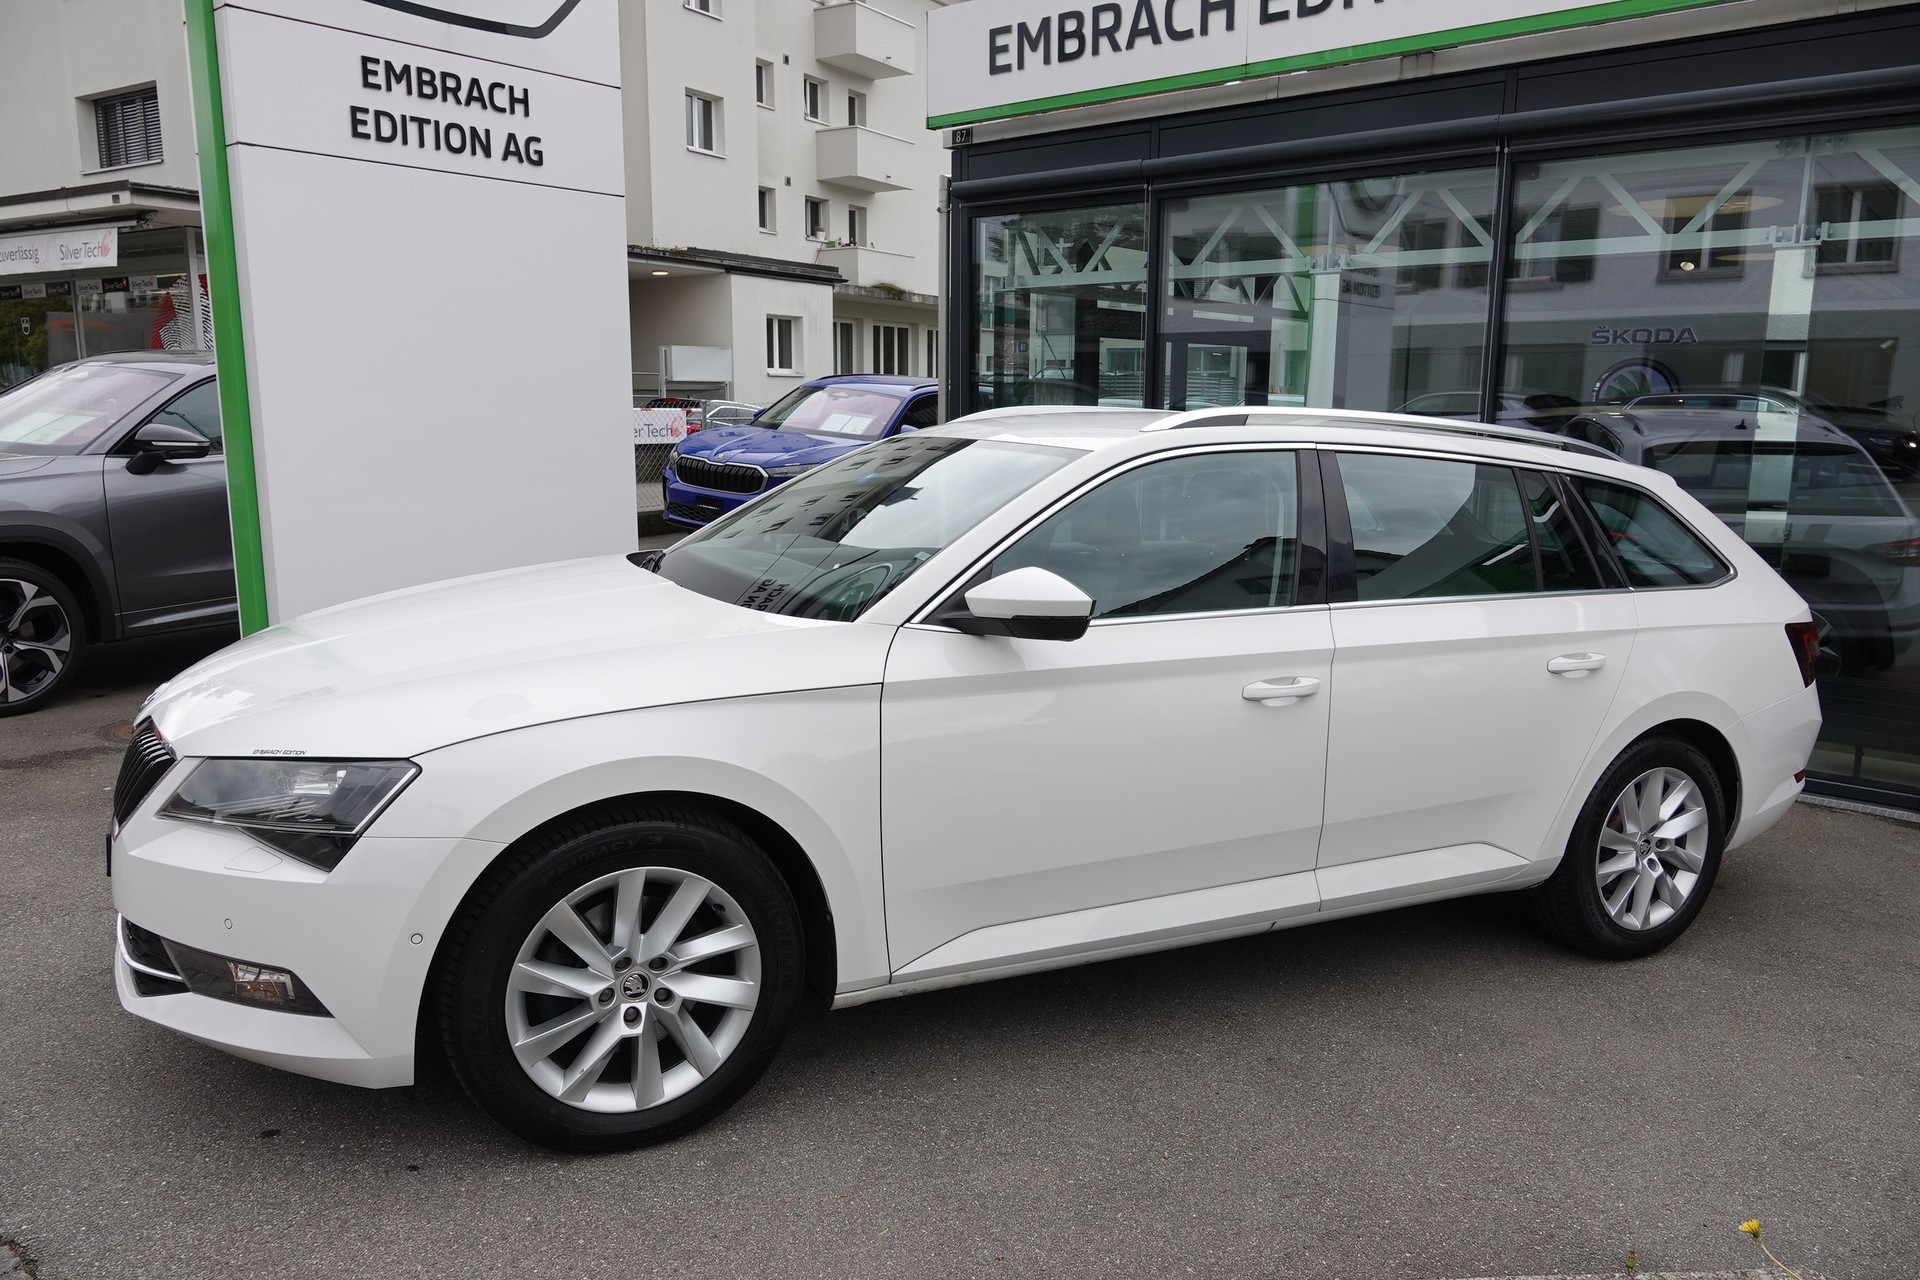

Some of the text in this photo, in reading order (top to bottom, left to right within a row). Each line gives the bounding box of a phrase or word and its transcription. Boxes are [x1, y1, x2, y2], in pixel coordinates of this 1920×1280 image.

[989, 0, 1235, 76] EMBRACH
[360, 55, 531, 118] EMBRACH
[350, 105, 544, 167] EDITION AG
[956, 130, 966, 143] 87
[1591, 325, 1698, 345] ŠKODA
